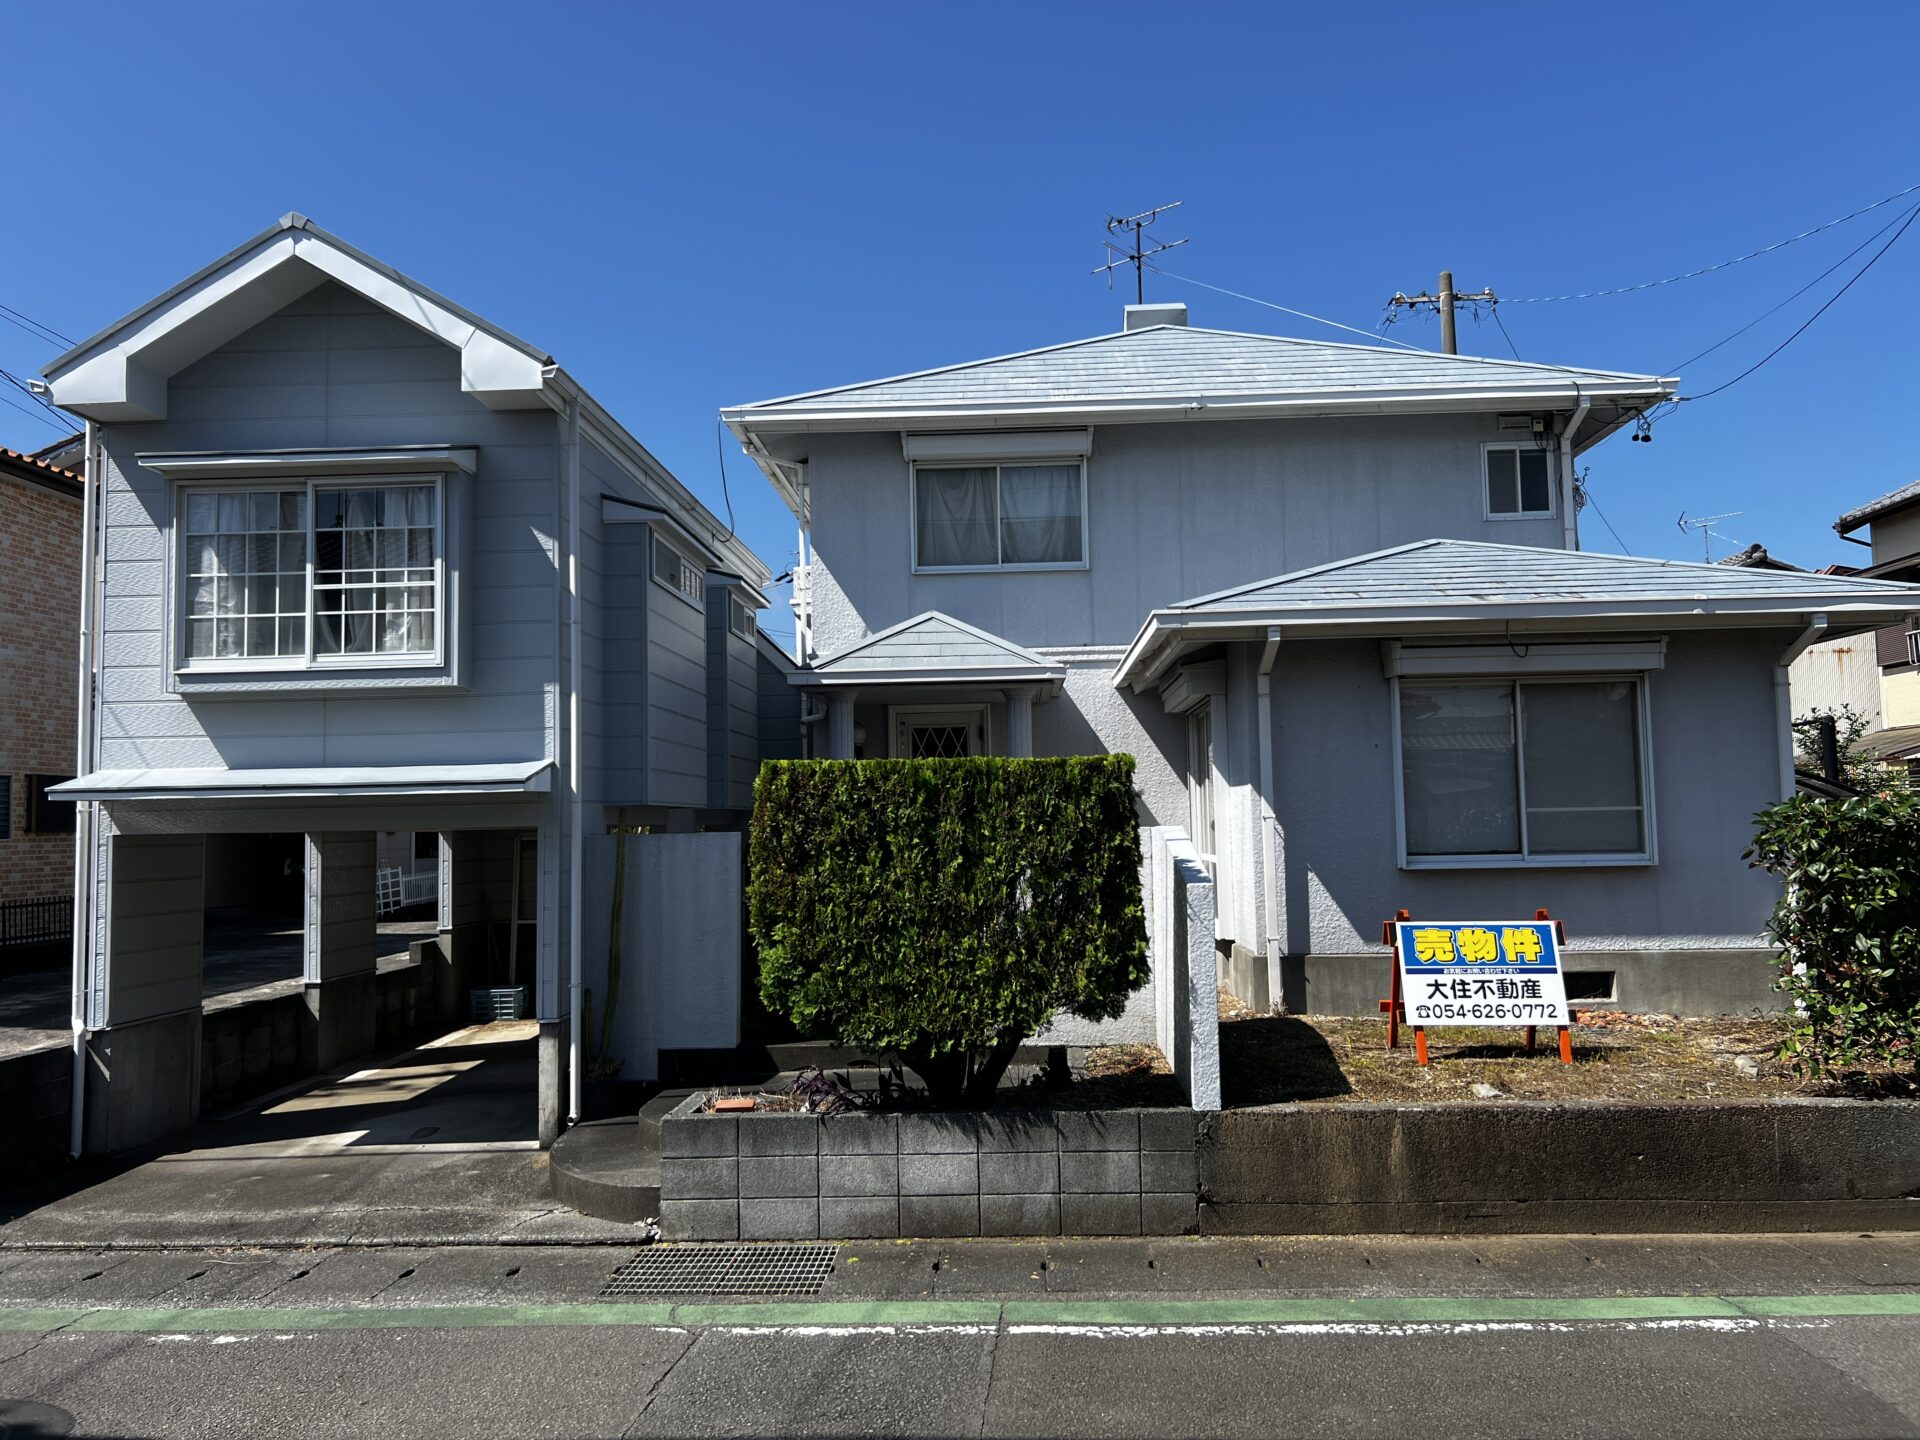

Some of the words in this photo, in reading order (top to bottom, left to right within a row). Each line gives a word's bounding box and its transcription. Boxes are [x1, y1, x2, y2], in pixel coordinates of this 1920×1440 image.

[1413, 927, 1542, 963] 売物件
[1426, 978, 1543, 1000] 大住不動産
[1432, 1003, 1558, 1019] 054-626-0772
